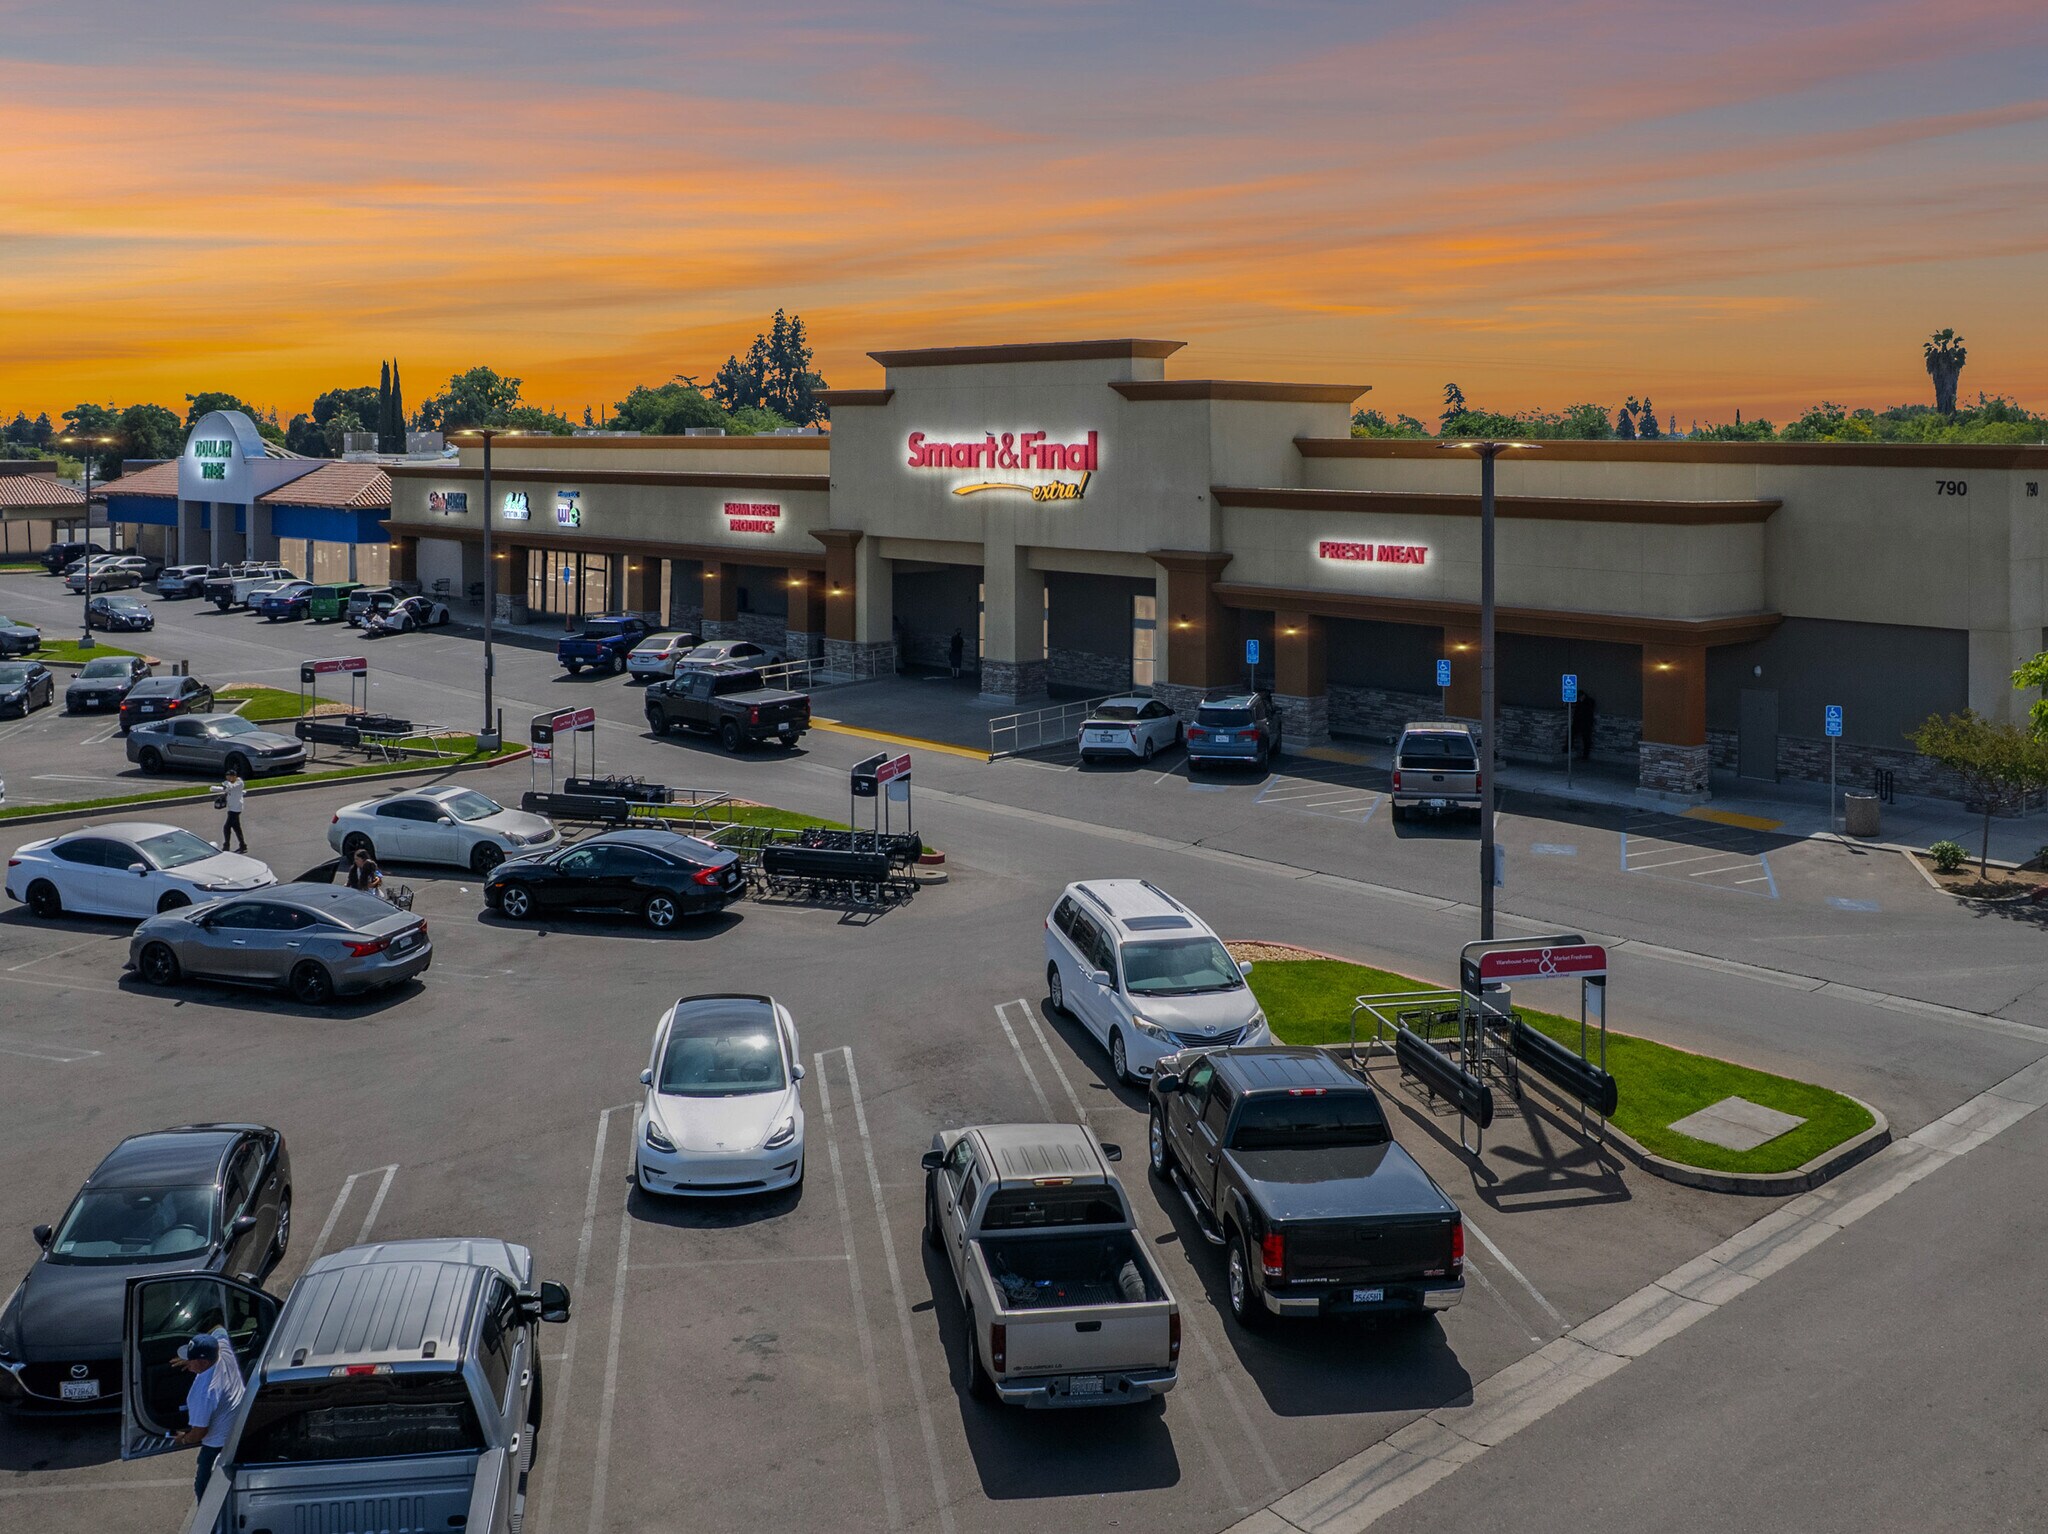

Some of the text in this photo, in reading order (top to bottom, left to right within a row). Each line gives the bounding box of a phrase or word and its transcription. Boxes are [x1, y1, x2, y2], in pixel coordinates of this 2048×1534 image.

[195, 440, 232, 457] DOLLAR
[201, 462, 225, 479] TREE
[1032, 471, 1091, 501] extra!
[1936, 481, 1967, 496] 790
[2026, 482, 2038, 497] 790
[724, 503, 780, 517] FARM FRESH
[730, 519, 775, 533] PRODUCE
[1319, 541, 1428, 565] FRESH MEAT
[1539, 949, 1557, 974] &
